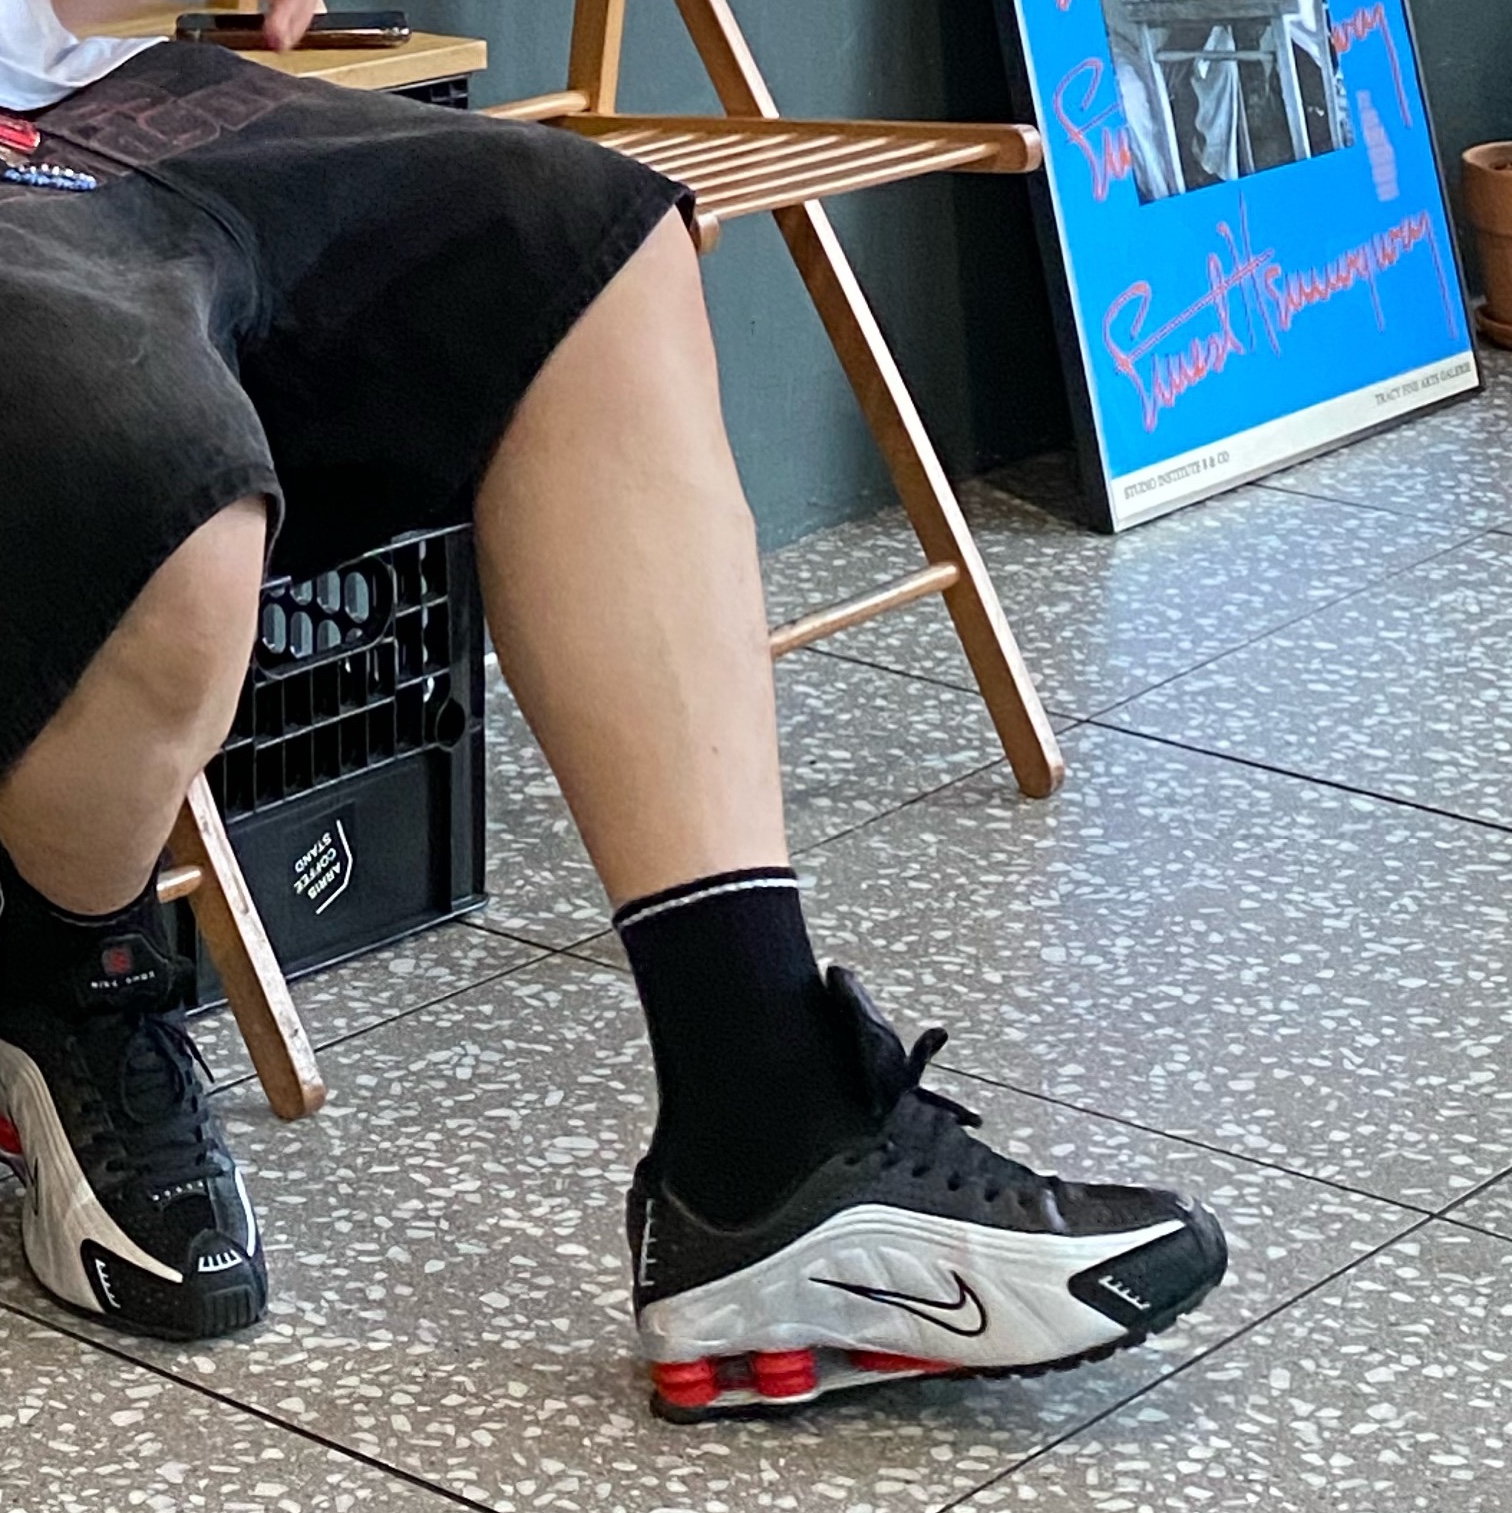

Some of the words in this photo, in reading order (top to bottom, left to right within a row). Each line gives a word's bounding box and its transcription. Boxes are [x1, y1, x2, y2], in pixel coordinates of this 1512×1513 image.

[1123, 477, 1157, 500] STUDIO
[293, 847, 337, 895] COFFEE
[294, 831, 333, 874] STAND
[307, 860, 341, 900] ARRIS
